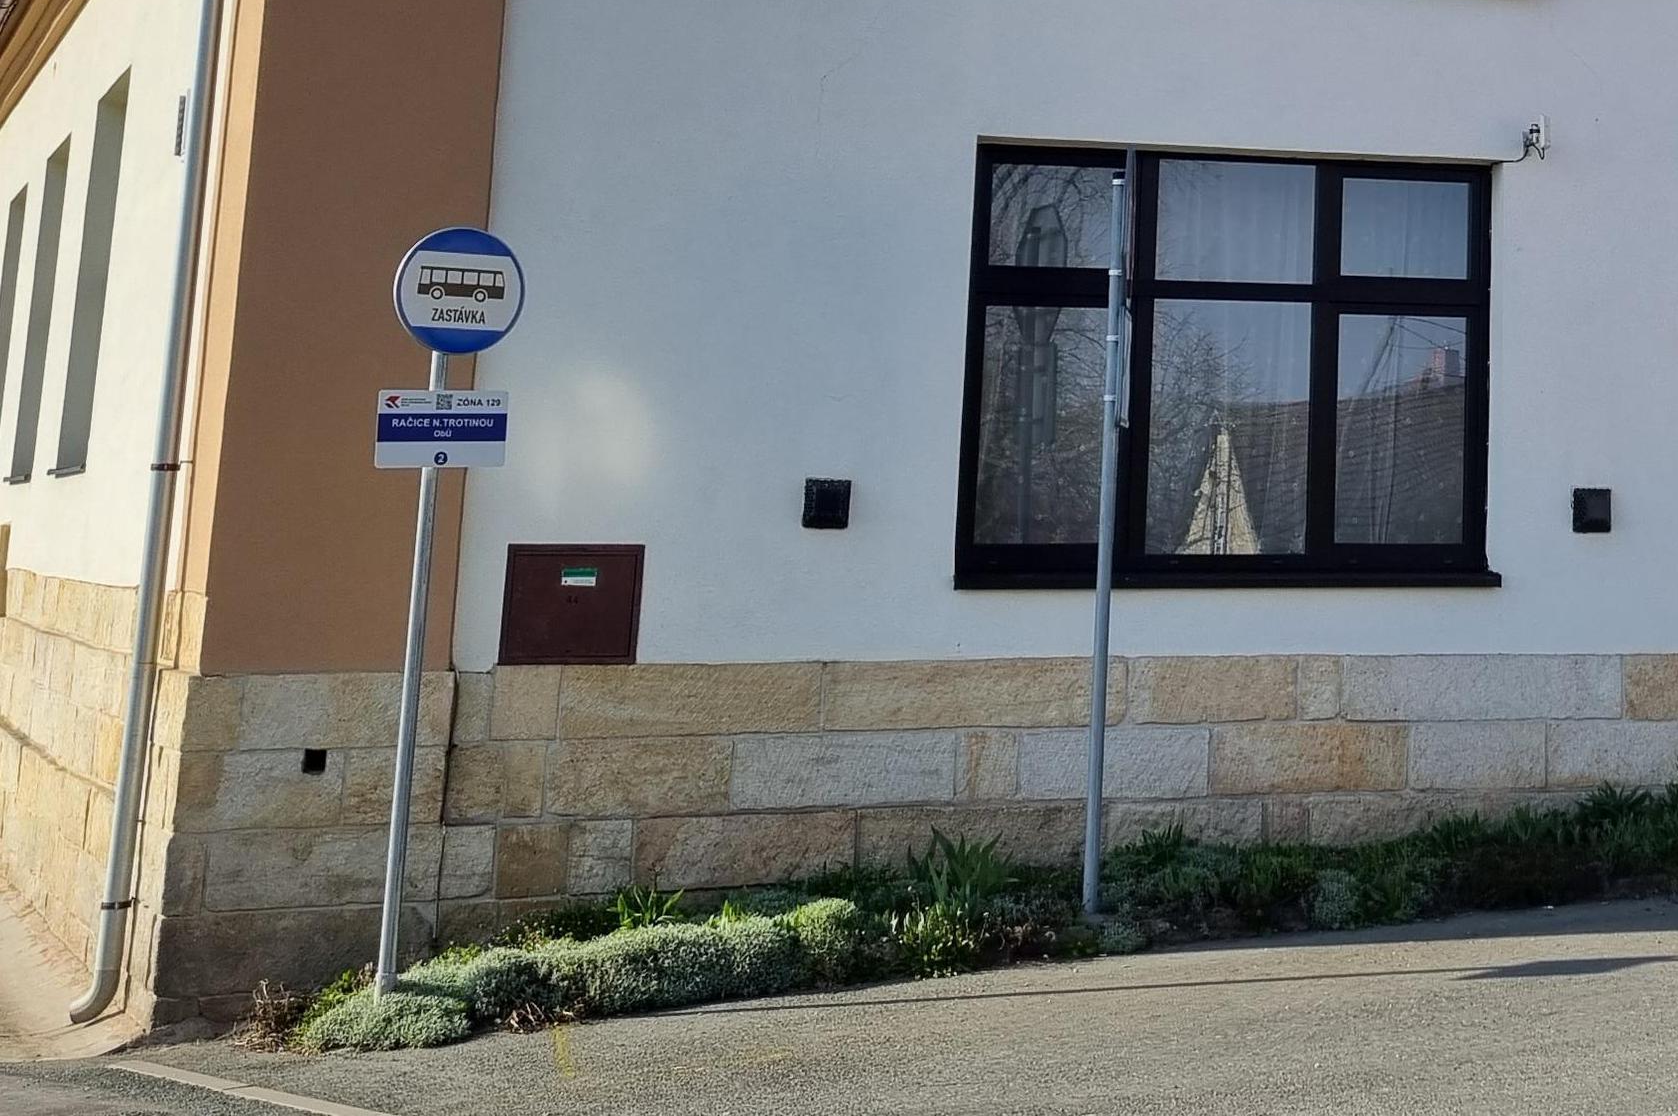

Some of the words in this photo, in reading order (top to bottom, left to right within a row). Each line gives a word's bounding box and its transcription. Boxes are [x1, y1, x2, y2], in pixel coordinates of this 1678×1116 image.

[431, 305, 485, 324] ZASTÁVKA
[457, 396, 483, 406] ZÓNA
[486, 398, 501, 407] 129
[392, 416, 430, 427] RAČICE
